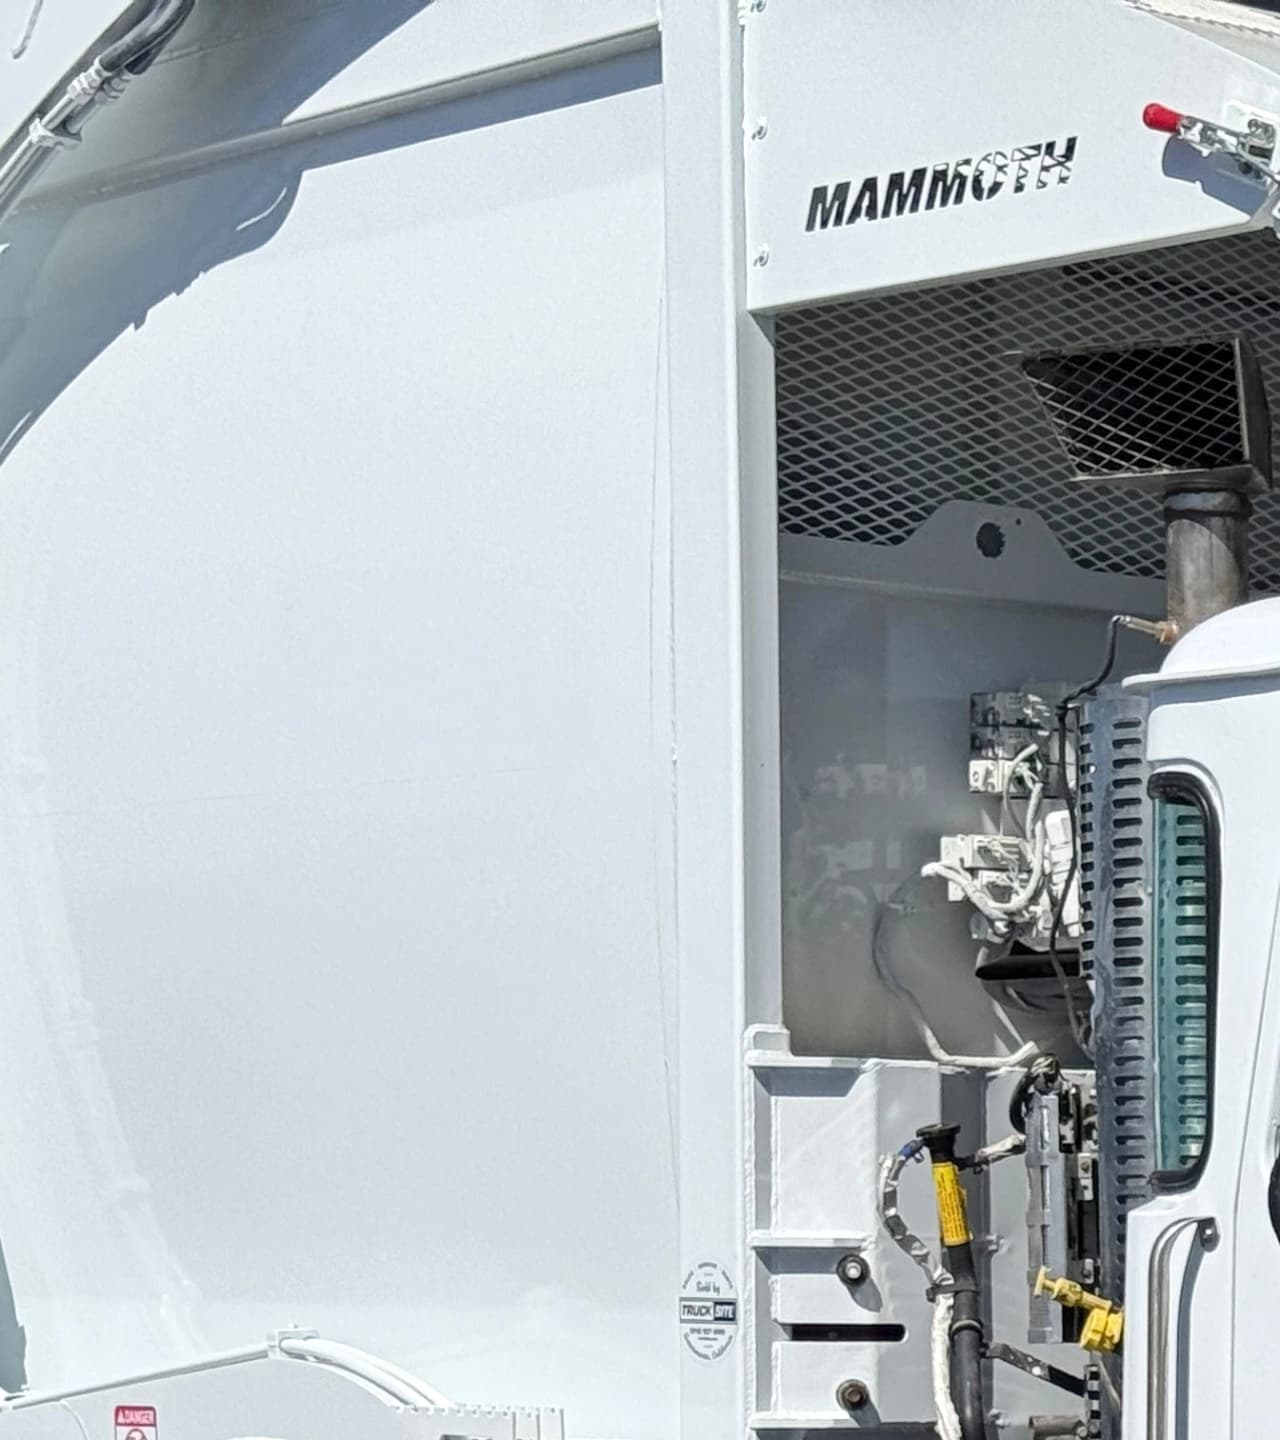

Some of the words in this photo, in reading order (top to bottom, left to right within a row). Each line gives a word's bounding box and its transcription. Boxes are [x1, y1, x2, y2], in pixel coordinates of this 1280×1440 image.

[804, 136, 1078, 232] MAMMOTH
[682, 1304, 712, 1317] TRUCK
[715, 1303, 735, 1317] SITE
